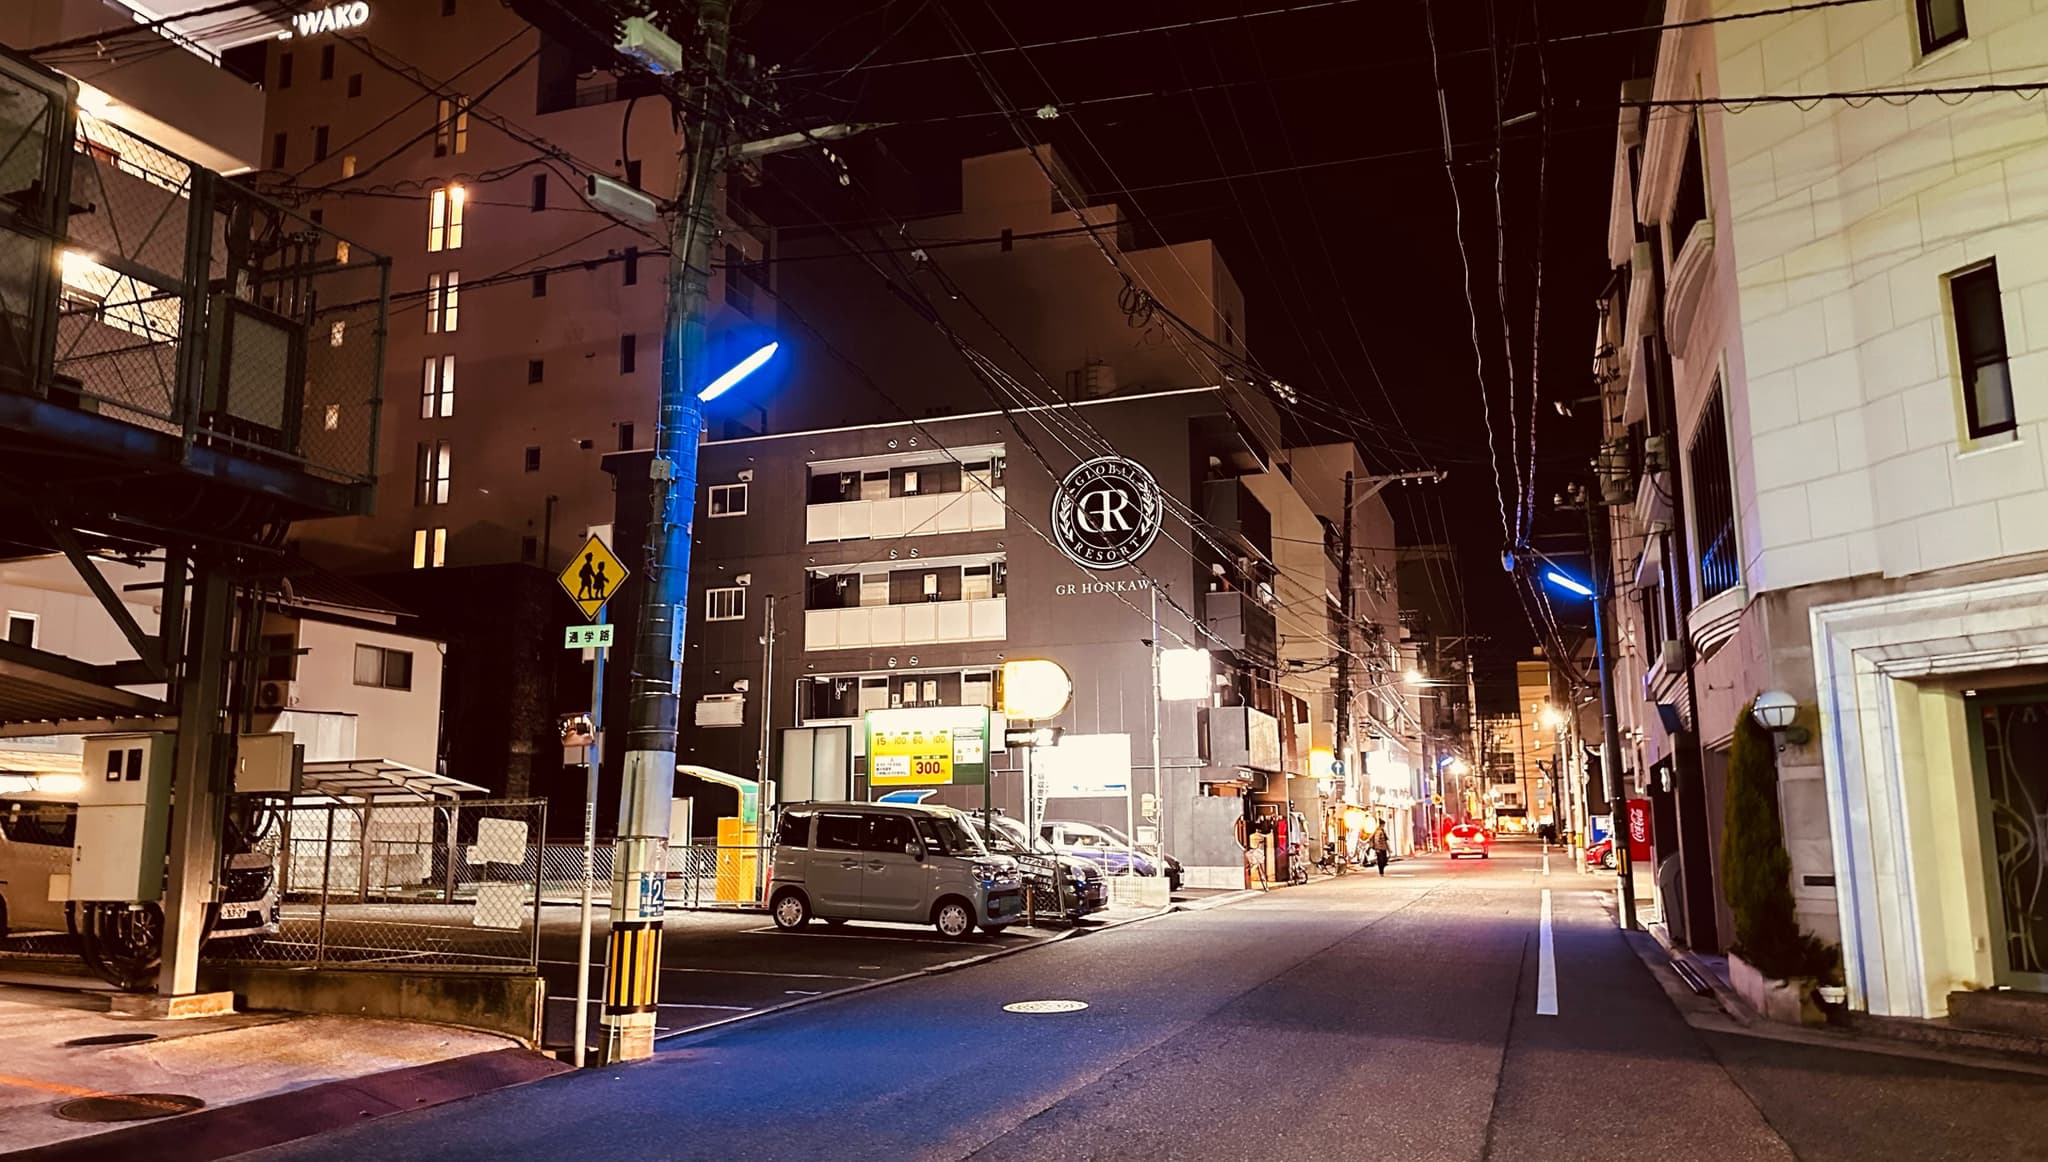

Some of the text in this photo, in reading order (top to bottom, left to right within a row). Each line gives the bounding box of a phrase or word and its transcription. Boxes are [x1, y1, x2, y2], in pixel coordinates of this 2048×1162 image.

[1075, 463, 1136, 486] GLOBAL
[1073, 537, 1141, 562] RESORT
[1055, 584, 1077, 596] GR
[568, 629, 610, 643] 通学路
